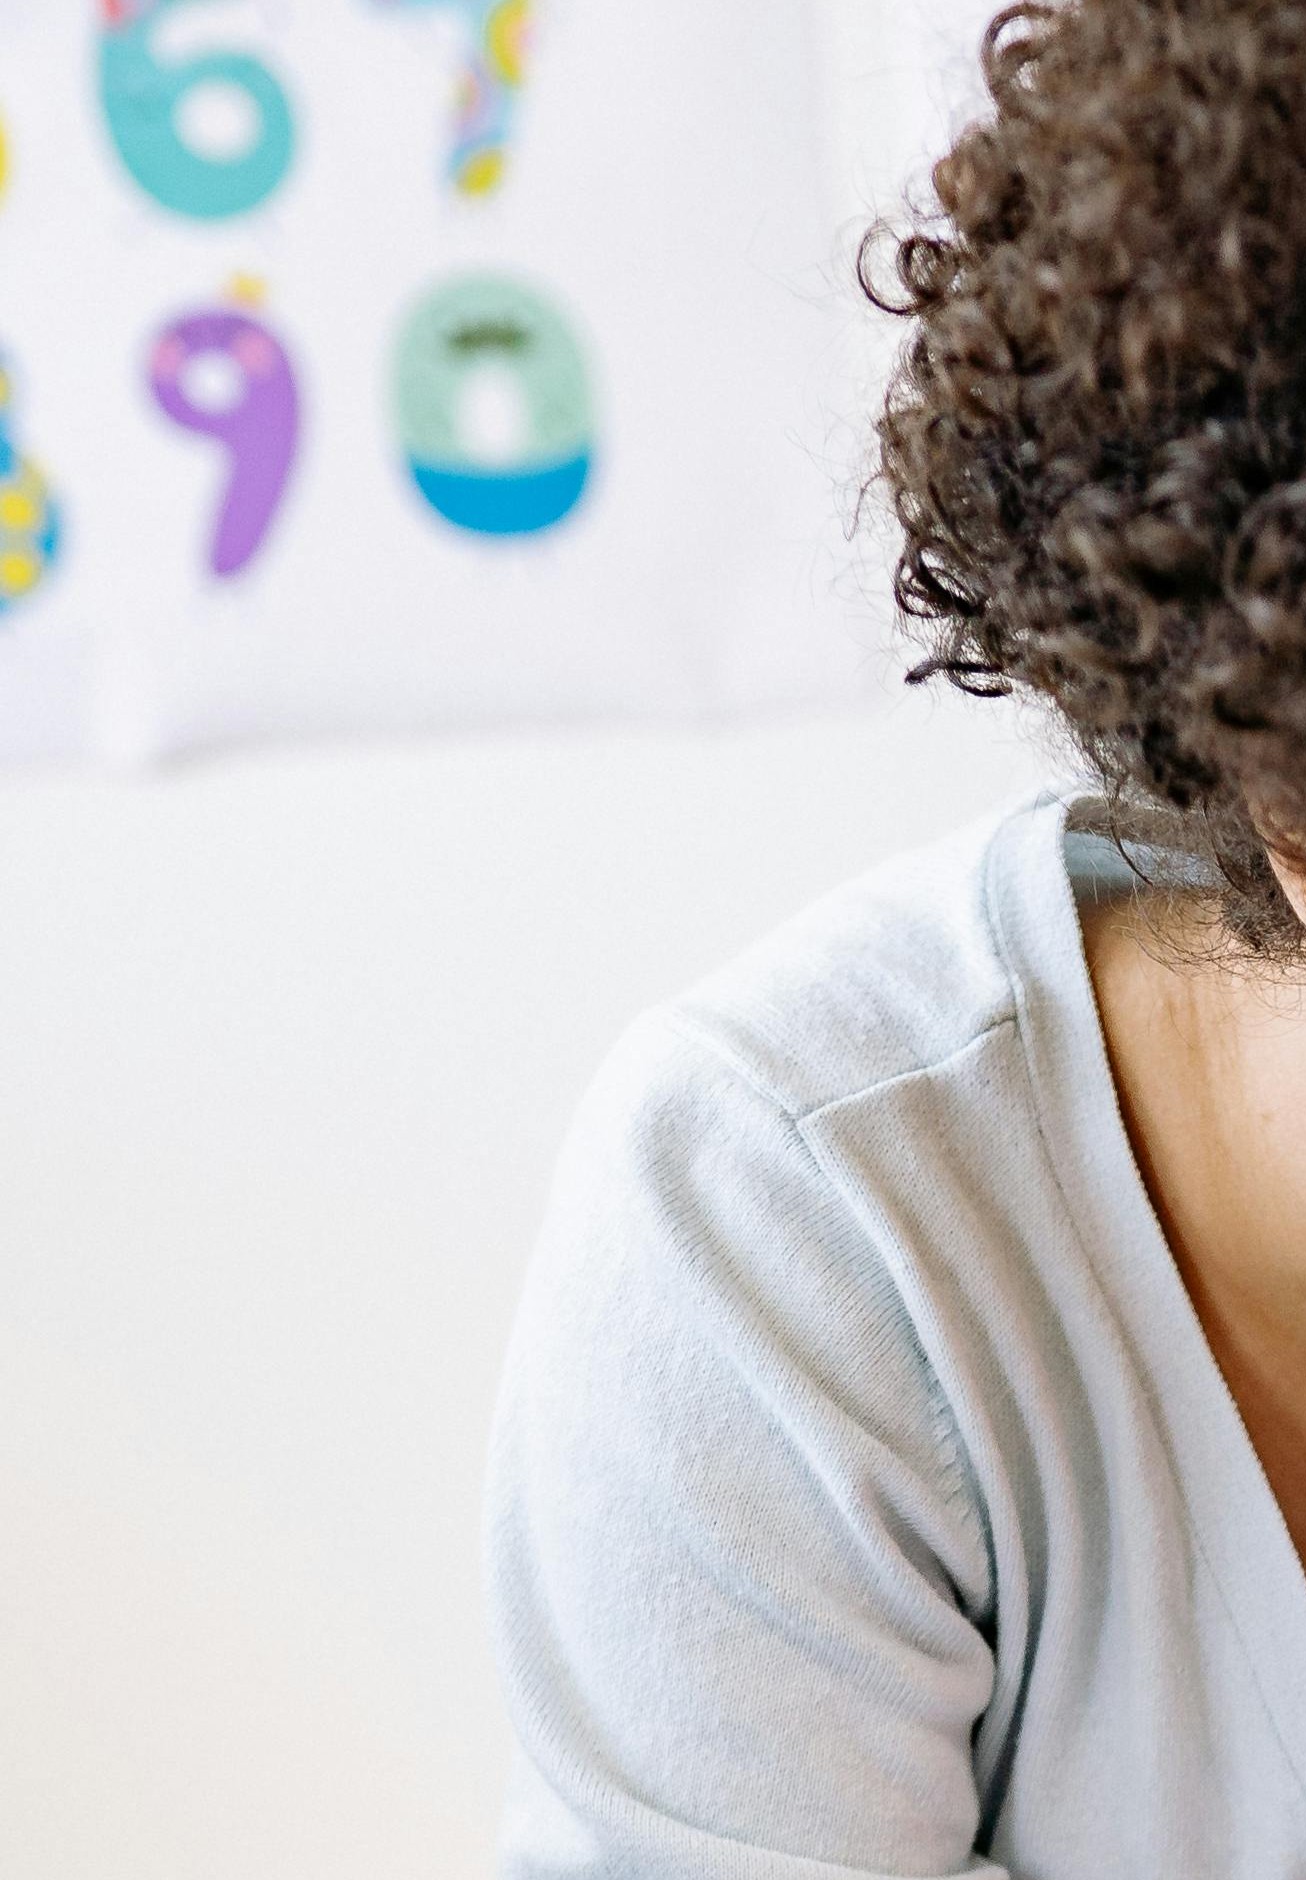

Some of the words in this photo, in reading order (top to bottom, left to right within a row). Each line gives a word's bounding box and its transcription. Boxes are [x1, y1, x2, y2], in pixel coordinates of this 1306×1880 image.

[94, 0, 300, 226] 6
[372, 0, 537, 203] 7
[146, 304, 304, 582] 9
[394, 274, 604, 550] 0
